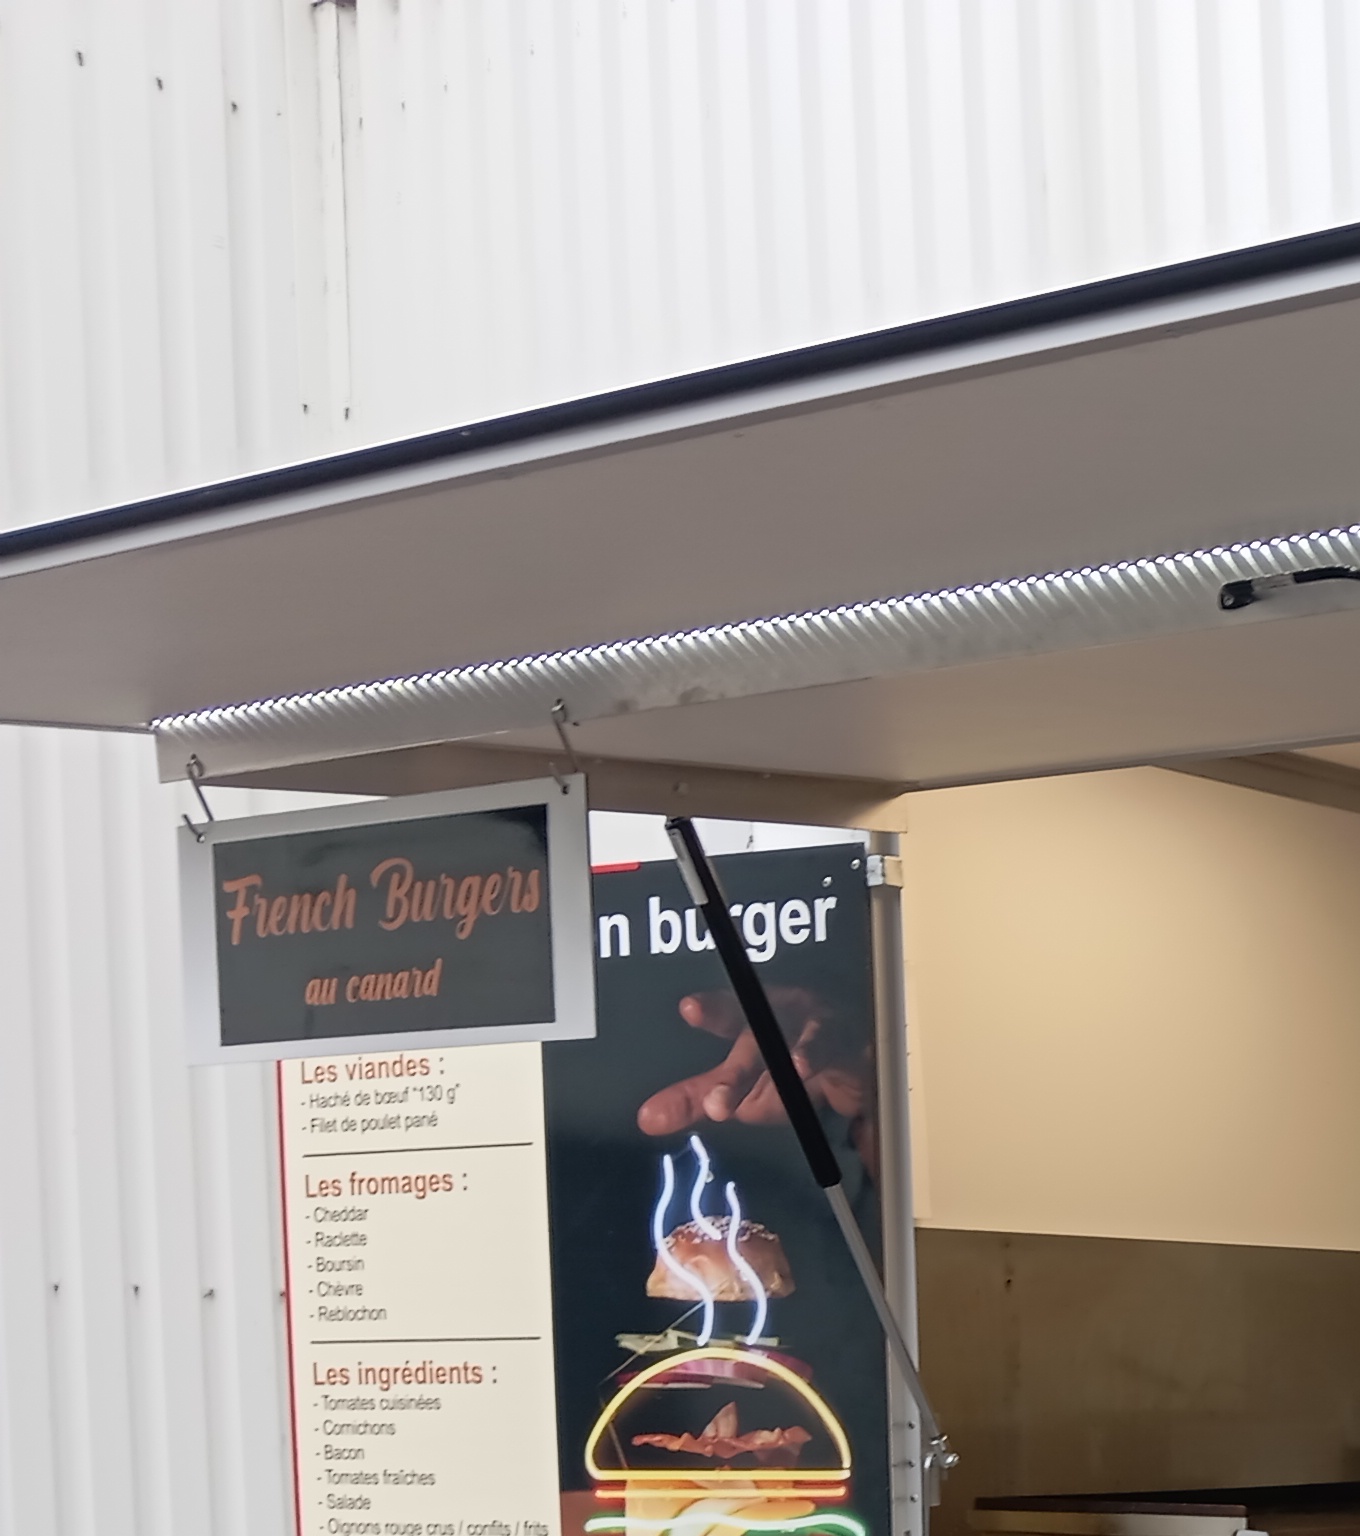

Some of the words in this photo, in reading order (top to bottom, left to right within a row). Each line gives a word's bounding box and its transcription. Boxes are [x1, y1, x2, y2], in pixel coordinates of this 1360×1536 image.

[223, 874, 356, 945] French
[370, 857, 541, 940] Burgers
[305, 977, 338, 1006] au
[345, 958, 443, 1003] canard
[301, 1061, 338, 1085] Les
[345, 1054, 430, 1080] viandes
[309, 1090, 350, 1109] Haché
[354, 1090, 370, 1106] de
[310, 1117, 337, 1133] Filet
[341, 1116, 356, 1132] de
[361, 1115, 400, 1134] poulet
[405, 1111, 438, 1132] pané
[305, 1174, 341, 1198] Les
[350, 1171, 453, 1199] fromages
[314, 1206, 369, 1222] Cheddar
[315, 1231, 367, 1247] Raclette
[316, 1256, 364, 1272] Boursin
[317, 1281, 363, 1296] Chèvre
[318, 1306, 387, 1321] Reblochon
[313, 1362, 350, 1385] Les
[358, 1361, 483, 1391] ingrédients
[323, 1420, 396, 1435] Cornichons
[324, 1444, 365, 1460] Bacon
[325, 1469, 379, 1485] Tomates
[327, 1494, 371, 1510] Salade
